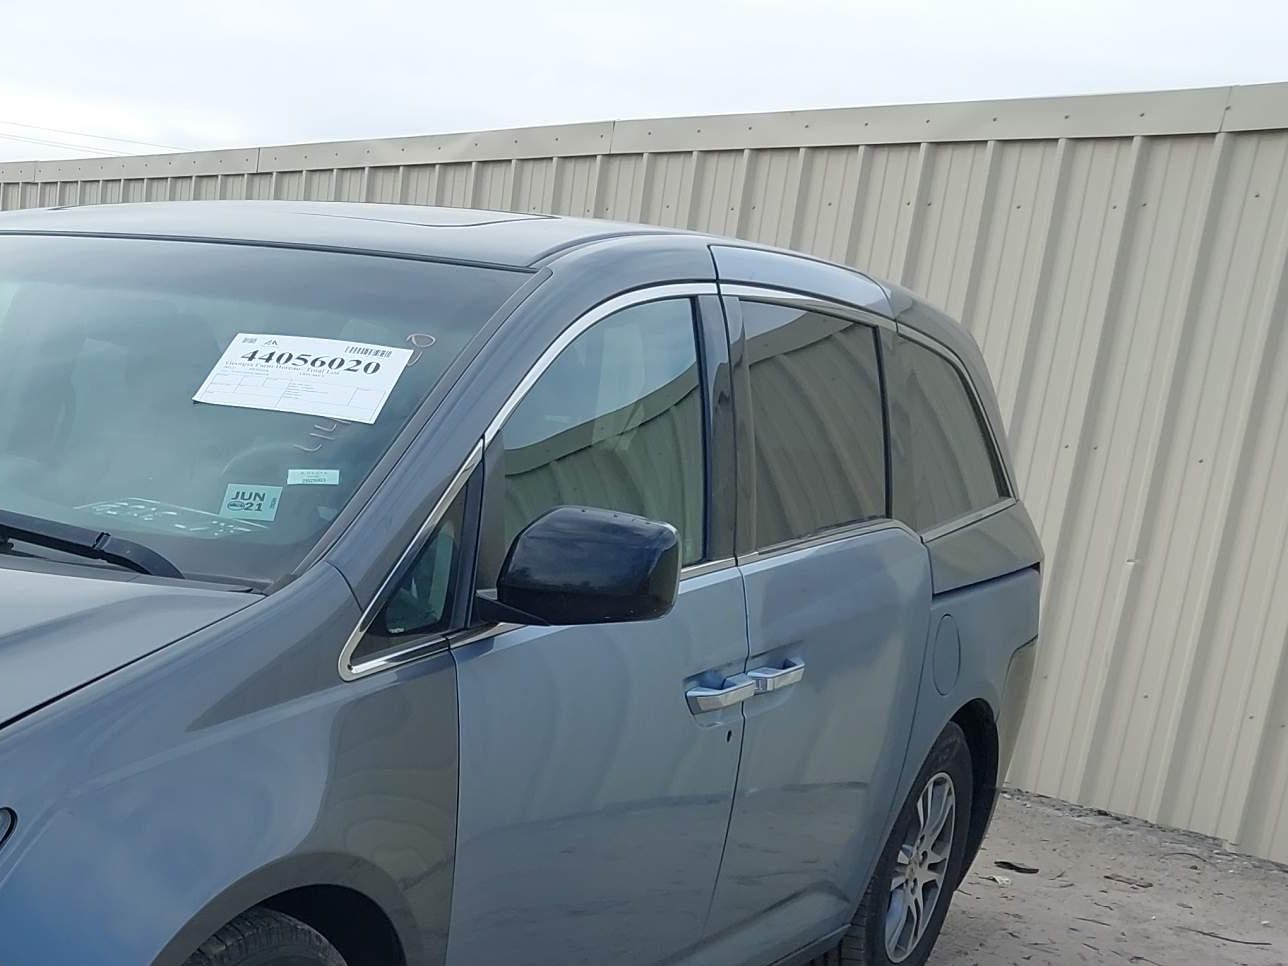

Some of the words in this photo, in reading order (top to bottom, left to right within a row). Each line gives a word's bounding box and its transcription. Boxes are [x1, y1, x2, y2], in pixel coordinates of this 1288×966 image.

[240, 349, 381, 375] 44056020
[231, 490, 266, 502] JUN
[244, 502, 263, 512] 21
